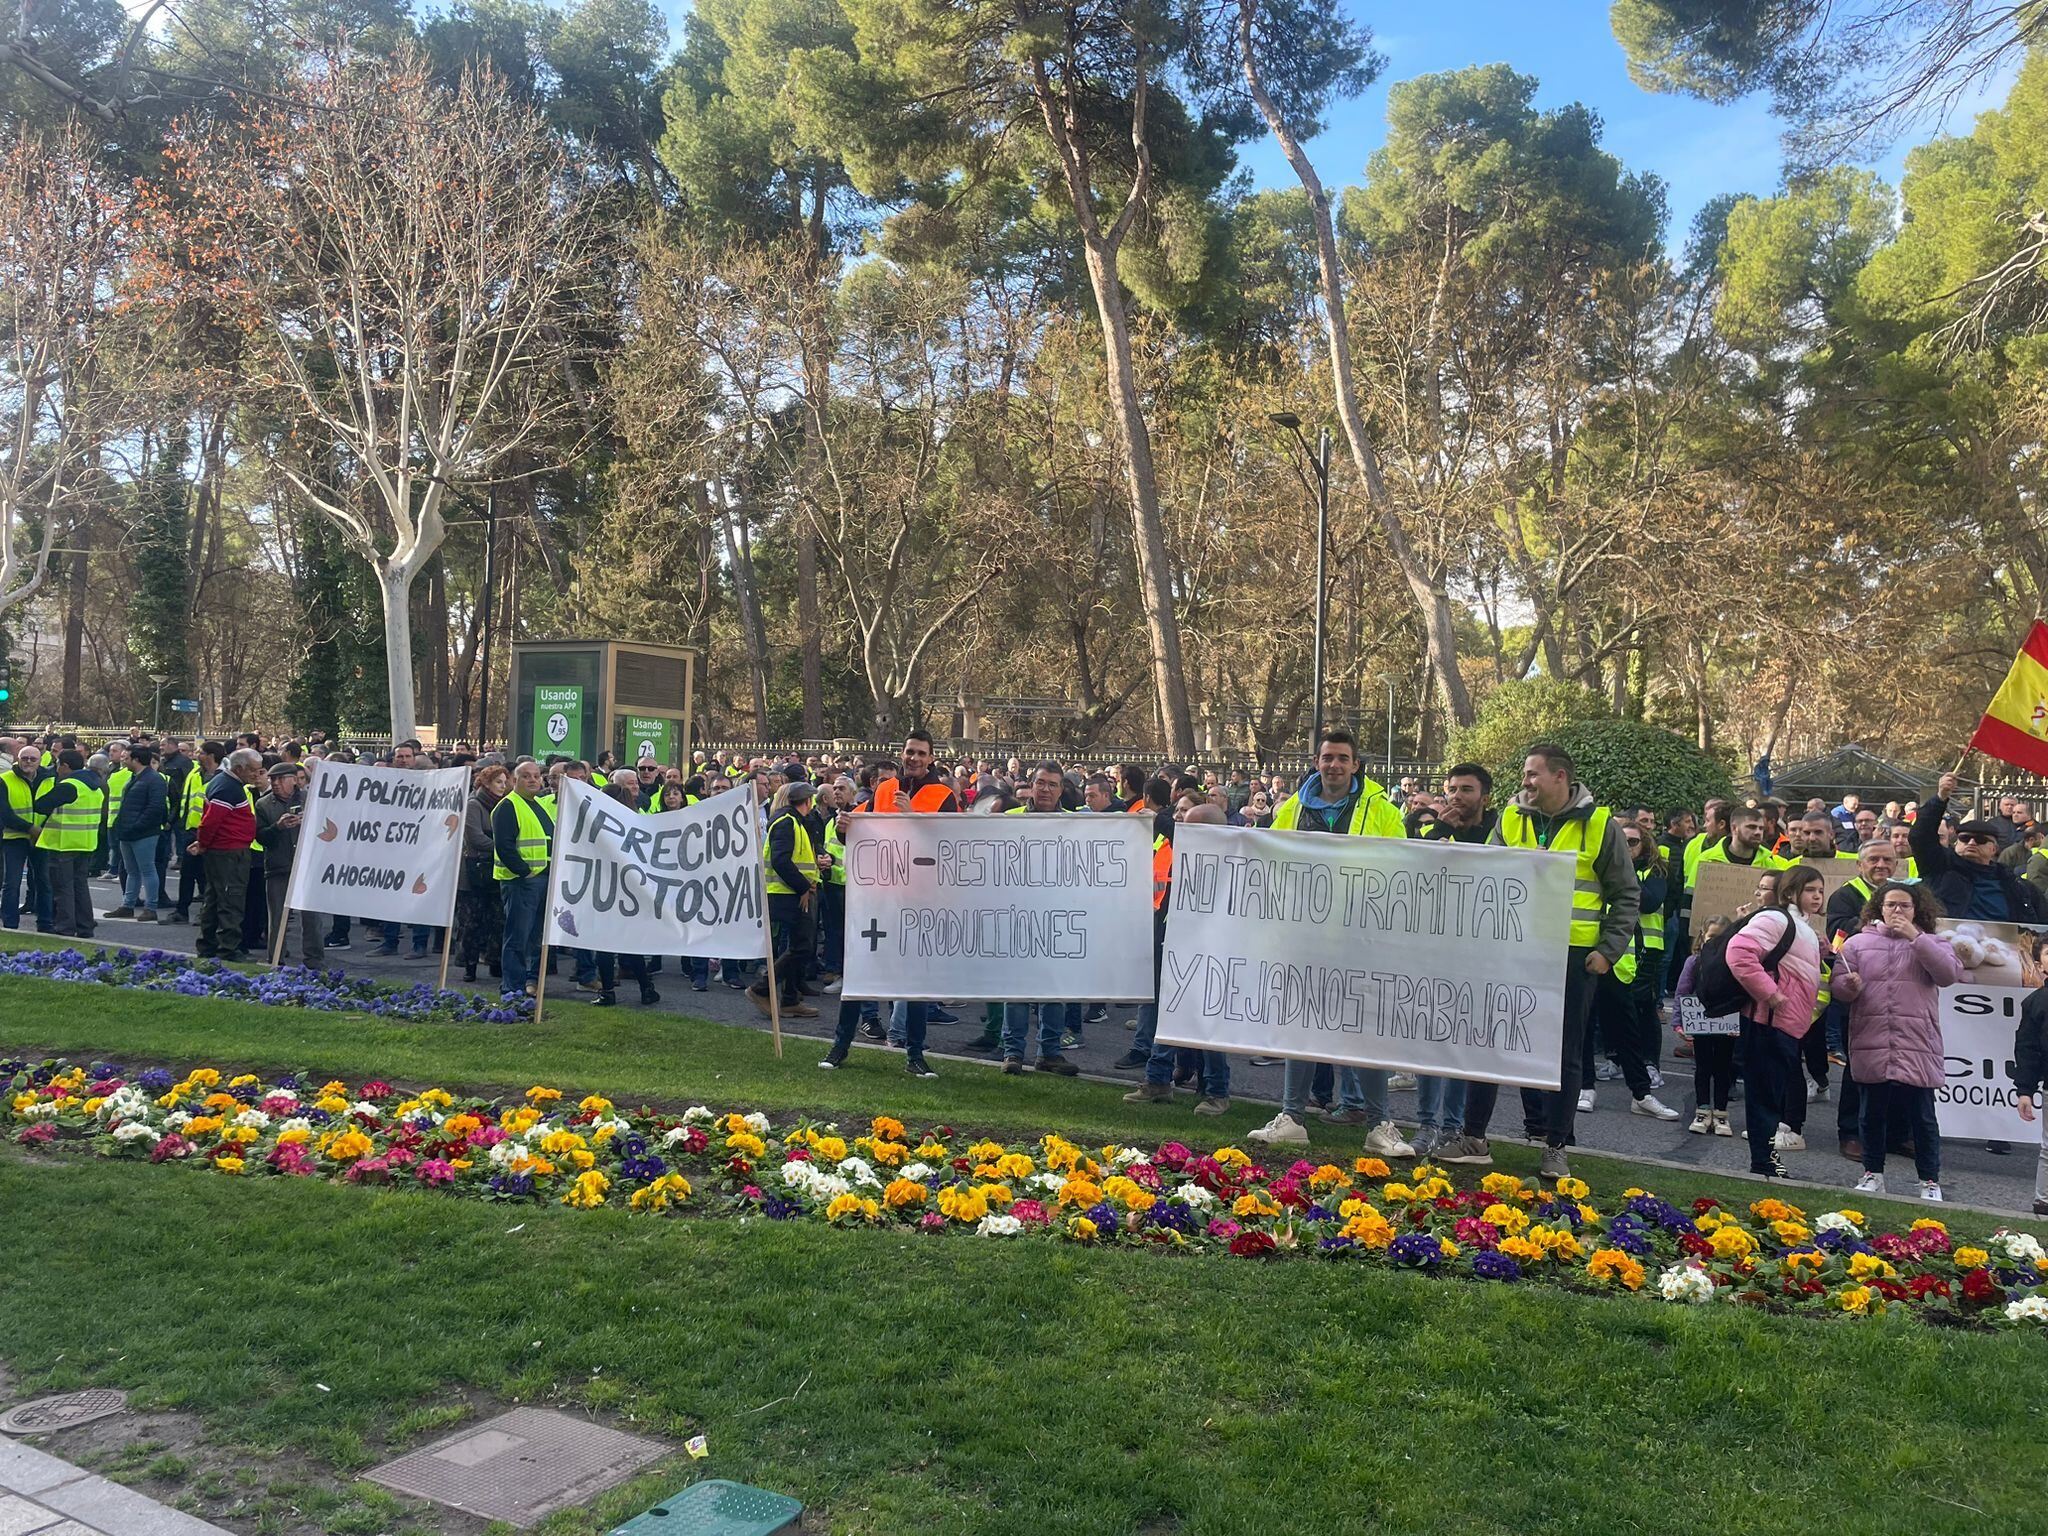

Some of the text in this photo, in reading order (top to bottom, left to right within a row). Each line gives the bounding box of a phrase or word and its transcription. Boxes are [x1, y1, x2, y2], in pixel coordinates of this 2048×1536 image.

[541, 689, 577, 700] Usando
[632, 719, 662, 730] Usando
[318, 772, 348, 799] LA
[347, 815, 426, 845] NOS ESTÁ
[852, 838, 910, 886] CON
[321, 863, 406, 891] AHOGANDO
[1176, 852, 1218, 913] NO
[1224, 855, 1332, 924] TANTO
[1166, 951, 1203, 1012] Y
[1372, 971, 1537, 1053] TRABAJAR
[1686, 1021, 1706, 1031] MI
